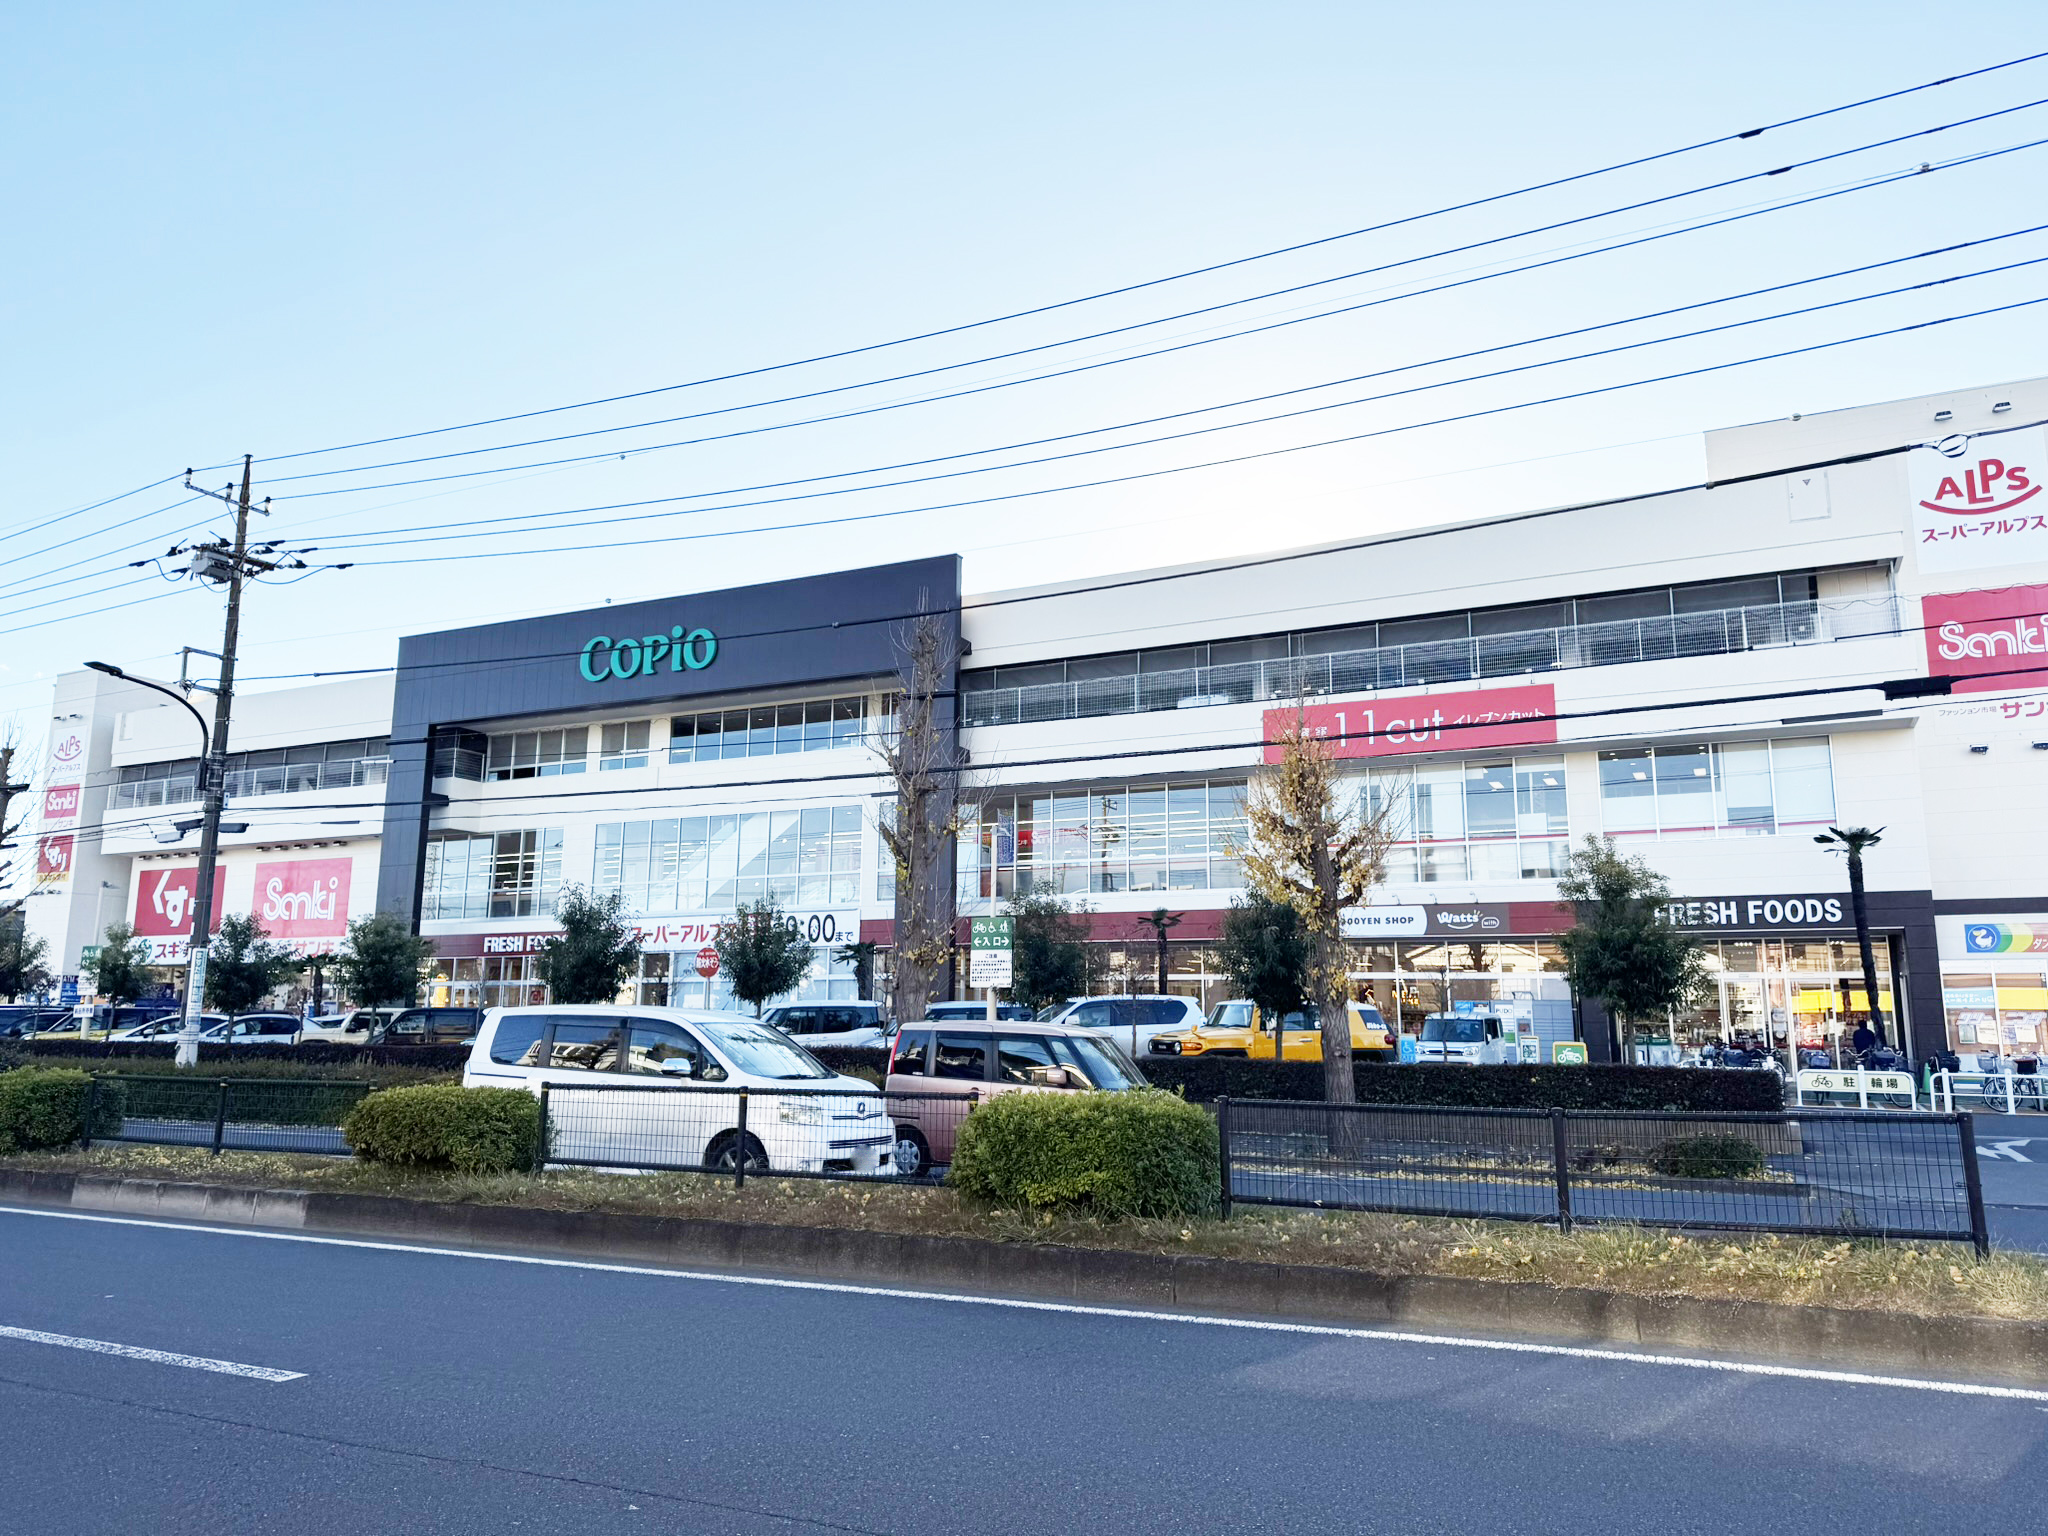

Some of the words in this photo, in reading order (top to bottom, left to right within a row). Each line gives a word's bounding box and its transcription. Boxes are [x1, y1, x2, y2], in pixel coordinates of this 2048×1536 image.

[1934, 458, 2030, 504] ALPS
[1922, 515, 2048, 543] スーパーアルプス
[1938, 613, 2048, 660] Sanki
[2000, 702, 2048, 719] サン
[57, 735, 81, 757] ALPS
[47, 790, 77, 811] Sanki
[43, 836, 67, 872] くすり
[263, 876, 339, 921] Sanki
[1385, 916, 1414, 925] SHOP
[1436, 911, 1479, 924] Watts
[1748, 898, 1843, 925] FOODS
[483, 936, 524, 953] FRESH
[834, 931, 854, 943] まで
[982, 936, 1001, 947] 入口
[1843, 1076, 1898, 1089] 駐輪場
